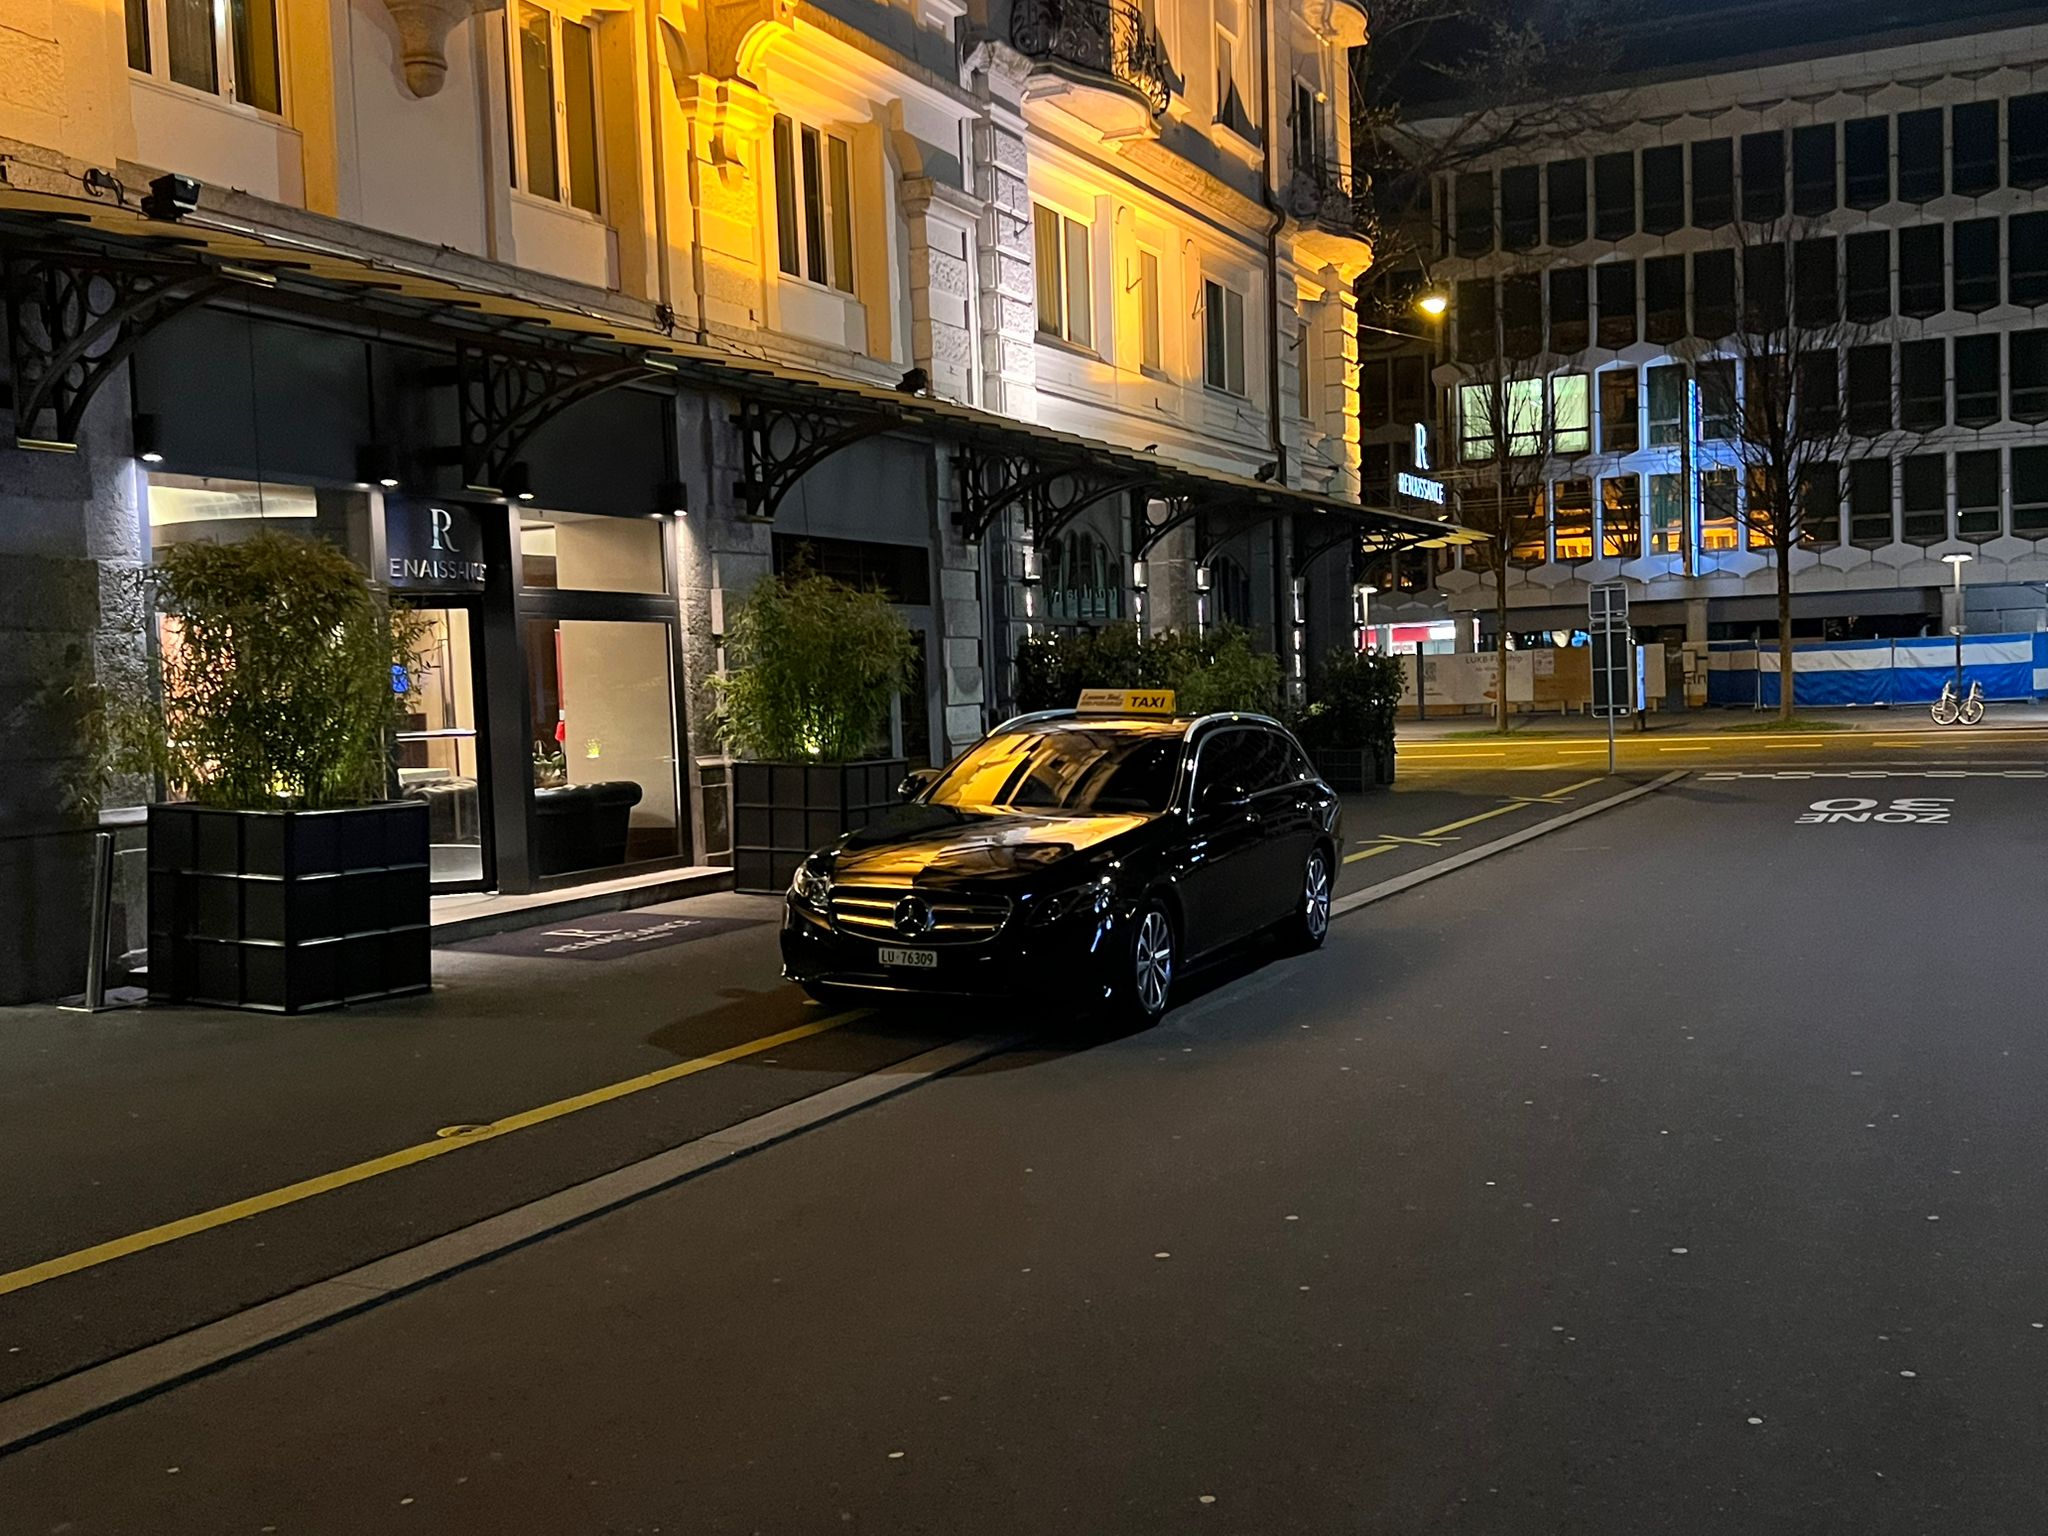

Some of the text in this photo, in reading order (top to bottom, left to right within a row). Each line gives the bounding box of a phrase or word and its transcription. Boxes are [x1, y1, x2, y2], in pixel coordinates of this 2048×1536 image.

[1414, 422, 1430, 470] R
[1398, 472, 1444, 505] RENAISSANCE
[429, 508, 461, 553] R
[1131, 696, 1166, 708] TAXI
[1809, 798, 1955, 812] 30
[1794, 812, 1951, 824] ZONE
[881, 950, 934, 966] LU 76309
